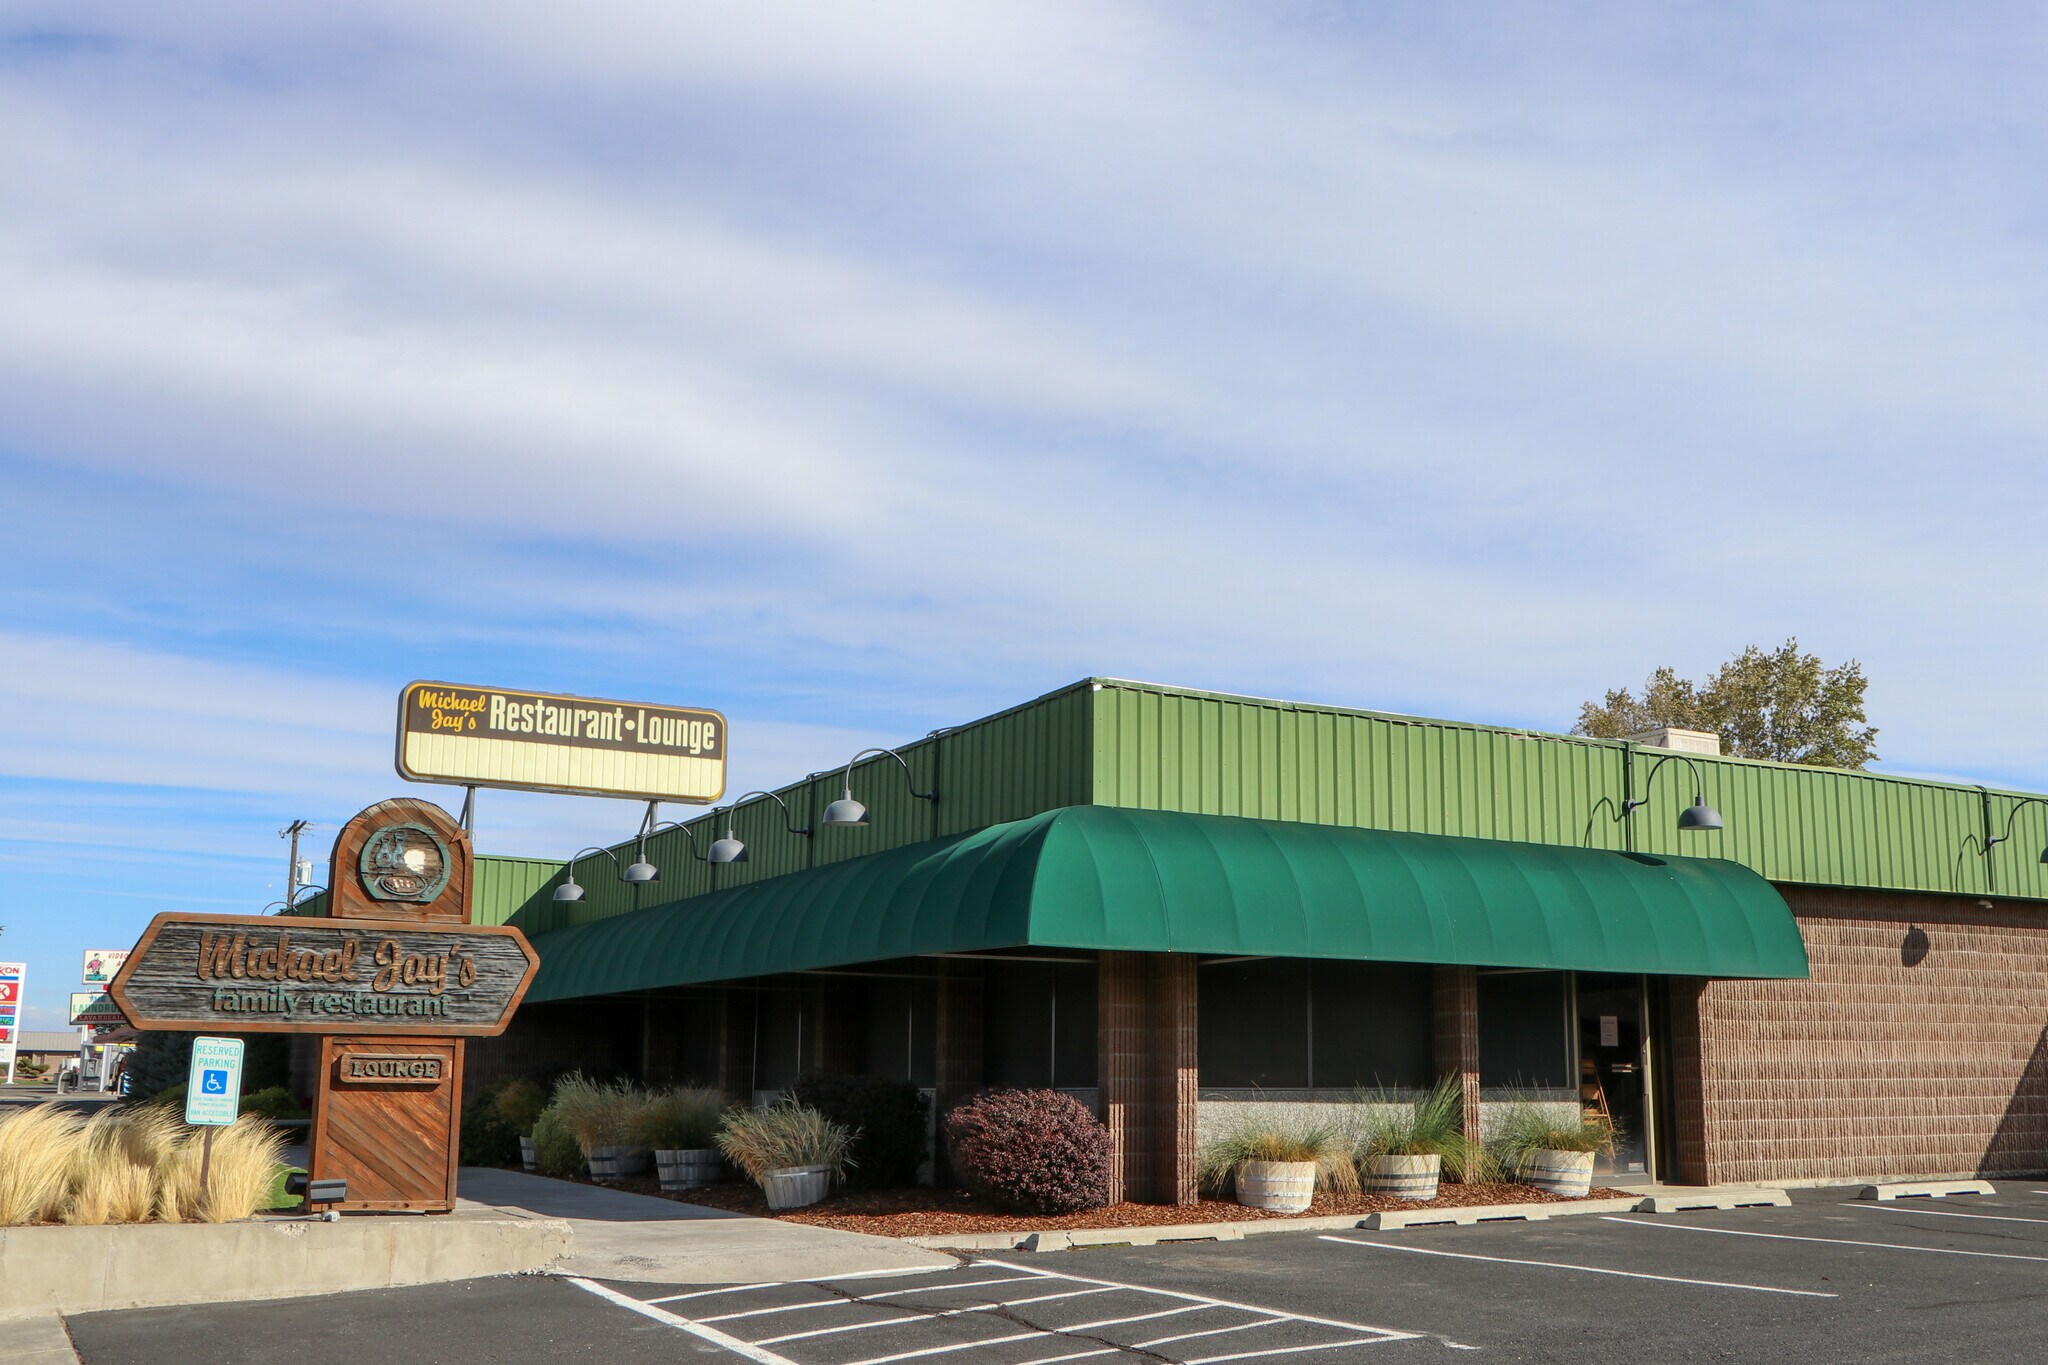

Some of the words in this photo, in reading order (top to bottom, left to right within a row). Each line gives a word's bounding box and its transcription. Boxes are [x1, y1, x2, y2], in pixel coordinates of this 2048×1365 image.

[419, 689, 487, 712] Michael
[431, 708, 477, 733] Jay's
[489, 695, 624, 741] Restaurant
[637, 709, 715, 755] Lounge
[198, 931, 361, 983] Michael
[372, 938, 477, 995] Jay's
[73, 1004, 118, 1013] LAUNDRO
[213, 985, 300, 1019] family
[311, 991, 453, 1017] restaurant
[197, 1045, 240, 1056] RESERVED
[198, 1058, 235, 1068] PARKING
[351, 1060, 441, 1079] LOUNGE
